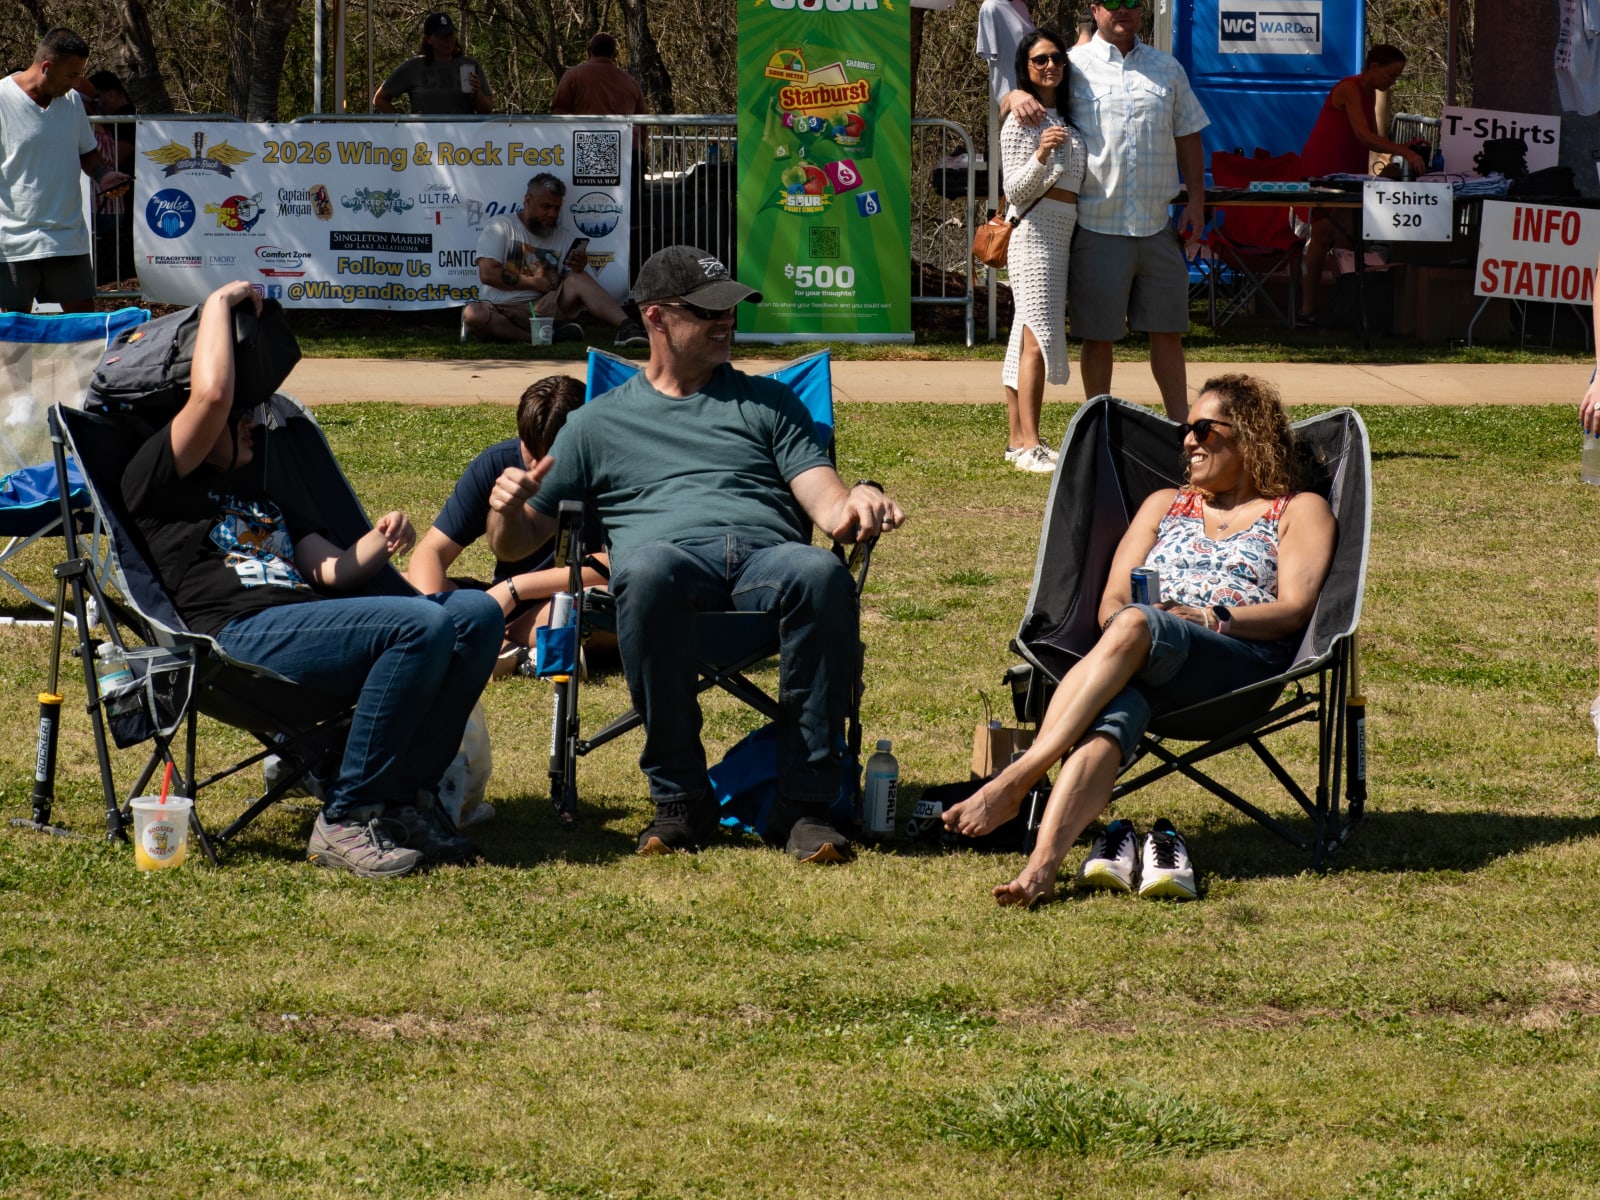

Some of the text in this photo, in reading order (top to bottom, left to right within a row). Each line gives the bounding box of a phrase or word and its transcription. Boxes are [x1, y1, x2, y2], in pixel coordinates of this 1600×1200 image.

[1222, 18, 1255, 34] WC
[769, 69, 804, 80] SOUR METER
[782, 81, 867, 107] Starburst
[1445, 114, 1556, 145] T-Shirts
[263, 141, 565, 172] 2026 Wing & Rock Fest
[277, 187, 311, 203] Captain
[419, 193, 460, 204] ULTRA
[787, 195, 821, 206] SOUR
[1376, 191, 1438, 207] T-Shirts
[155, 195, 189, 216] pulse
[277, 203, 312, 217] Morgan
[348, 198, 380, 209] WICKED
[570, 203, 624, 214] CANTON
[1392, 213, 1422, 228] $20
[1512, 207, 1581, 246] INFO
[333, 232, 430, 245] SINGLETON MARINE
[376, 243, 419, 251] ALLATOONA
[209, 255, 237, 263] EMORY
[338, 256, 432, 277] Follow Us
[784, 263, 855, 288] $500
[1481, 258, 1598, 301] STATION
[288, 281, 480, 303] @WingandRockFest
[38, 725, 50, 774] ROCKER
